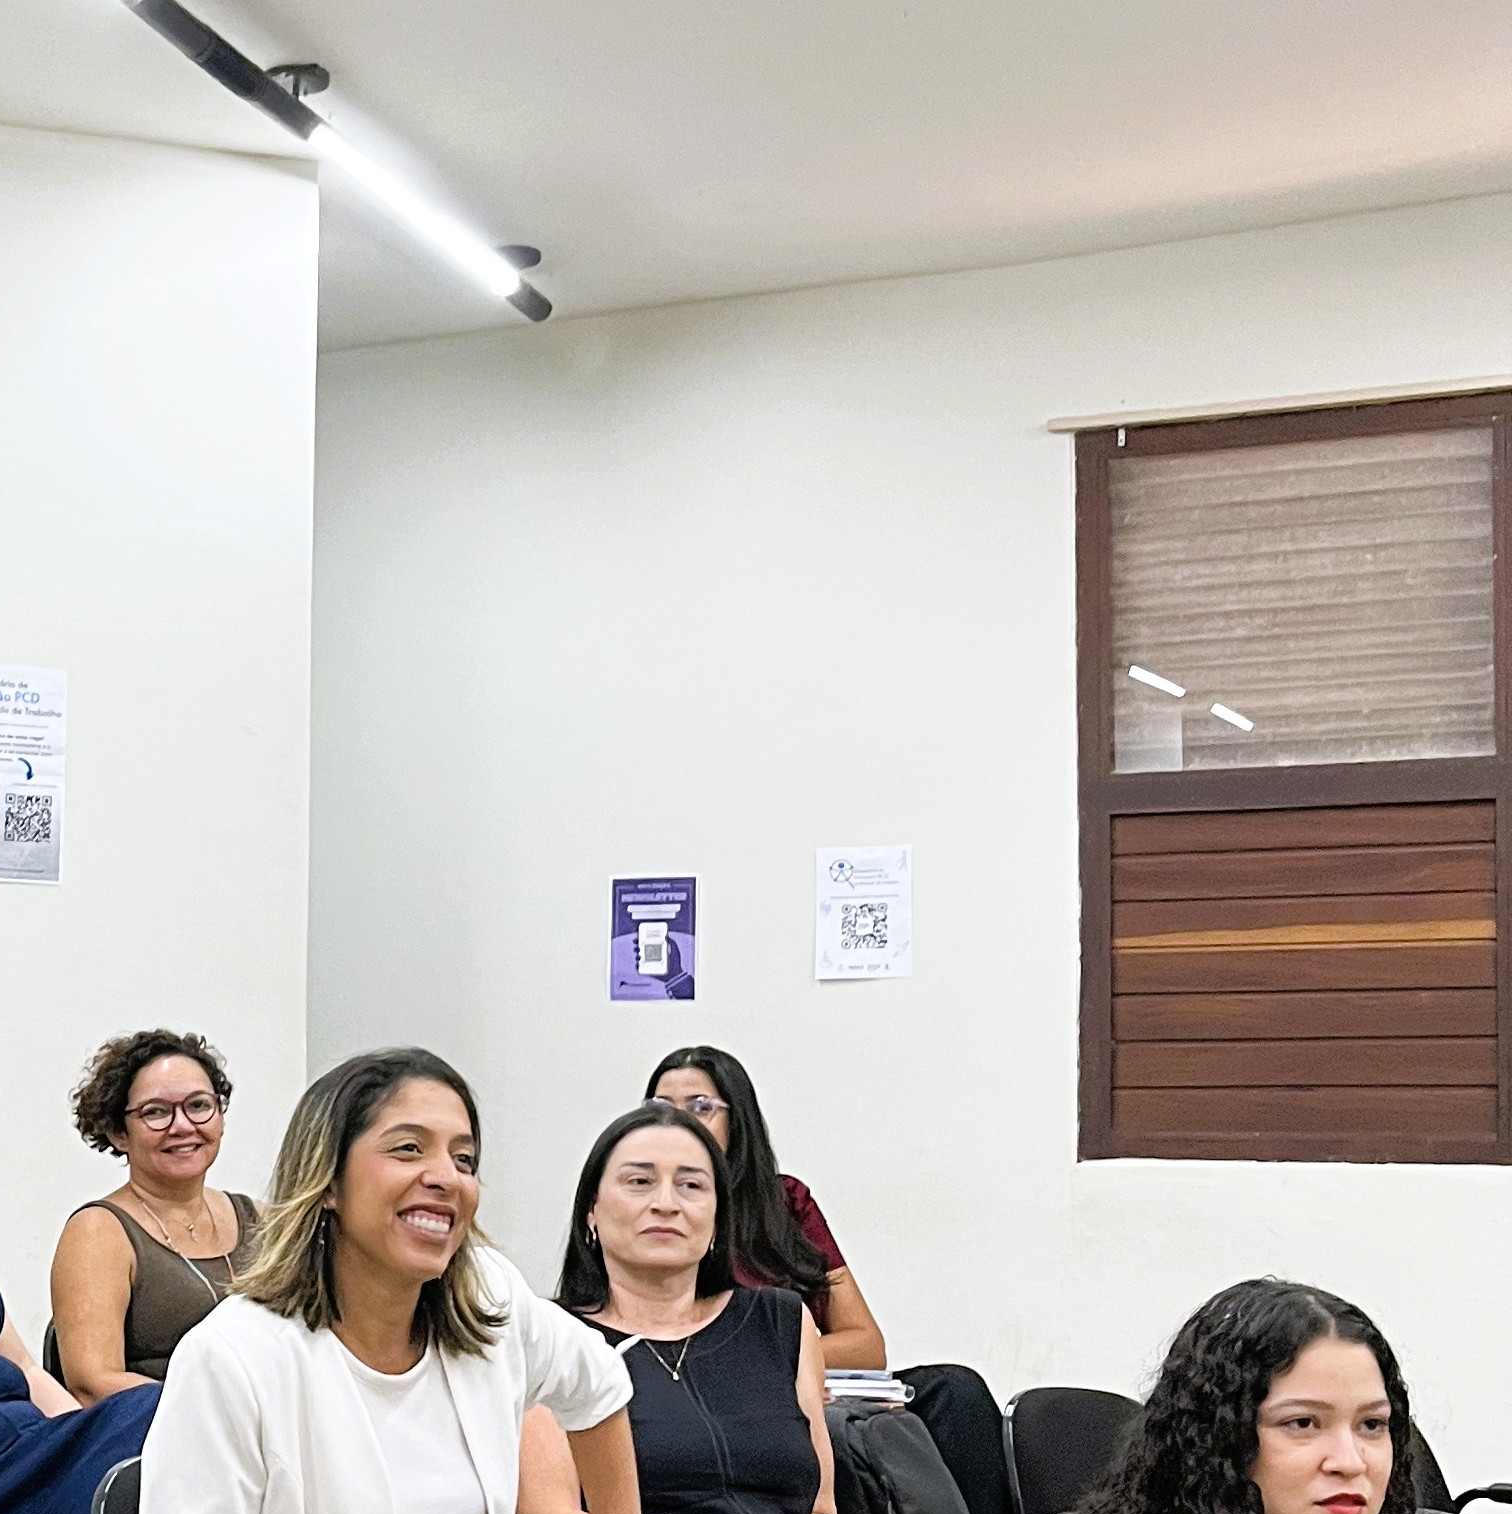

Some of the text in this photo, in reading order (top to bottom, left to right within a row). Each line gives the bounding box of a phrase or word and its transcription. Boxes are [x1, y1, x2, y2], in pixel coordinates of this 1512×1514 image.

[17, 681, 28, 689] de
[14, 691, 40, 704] PCD
[12, 707, 22, 715] de
[25, 707, 63, 718] Trabalho
